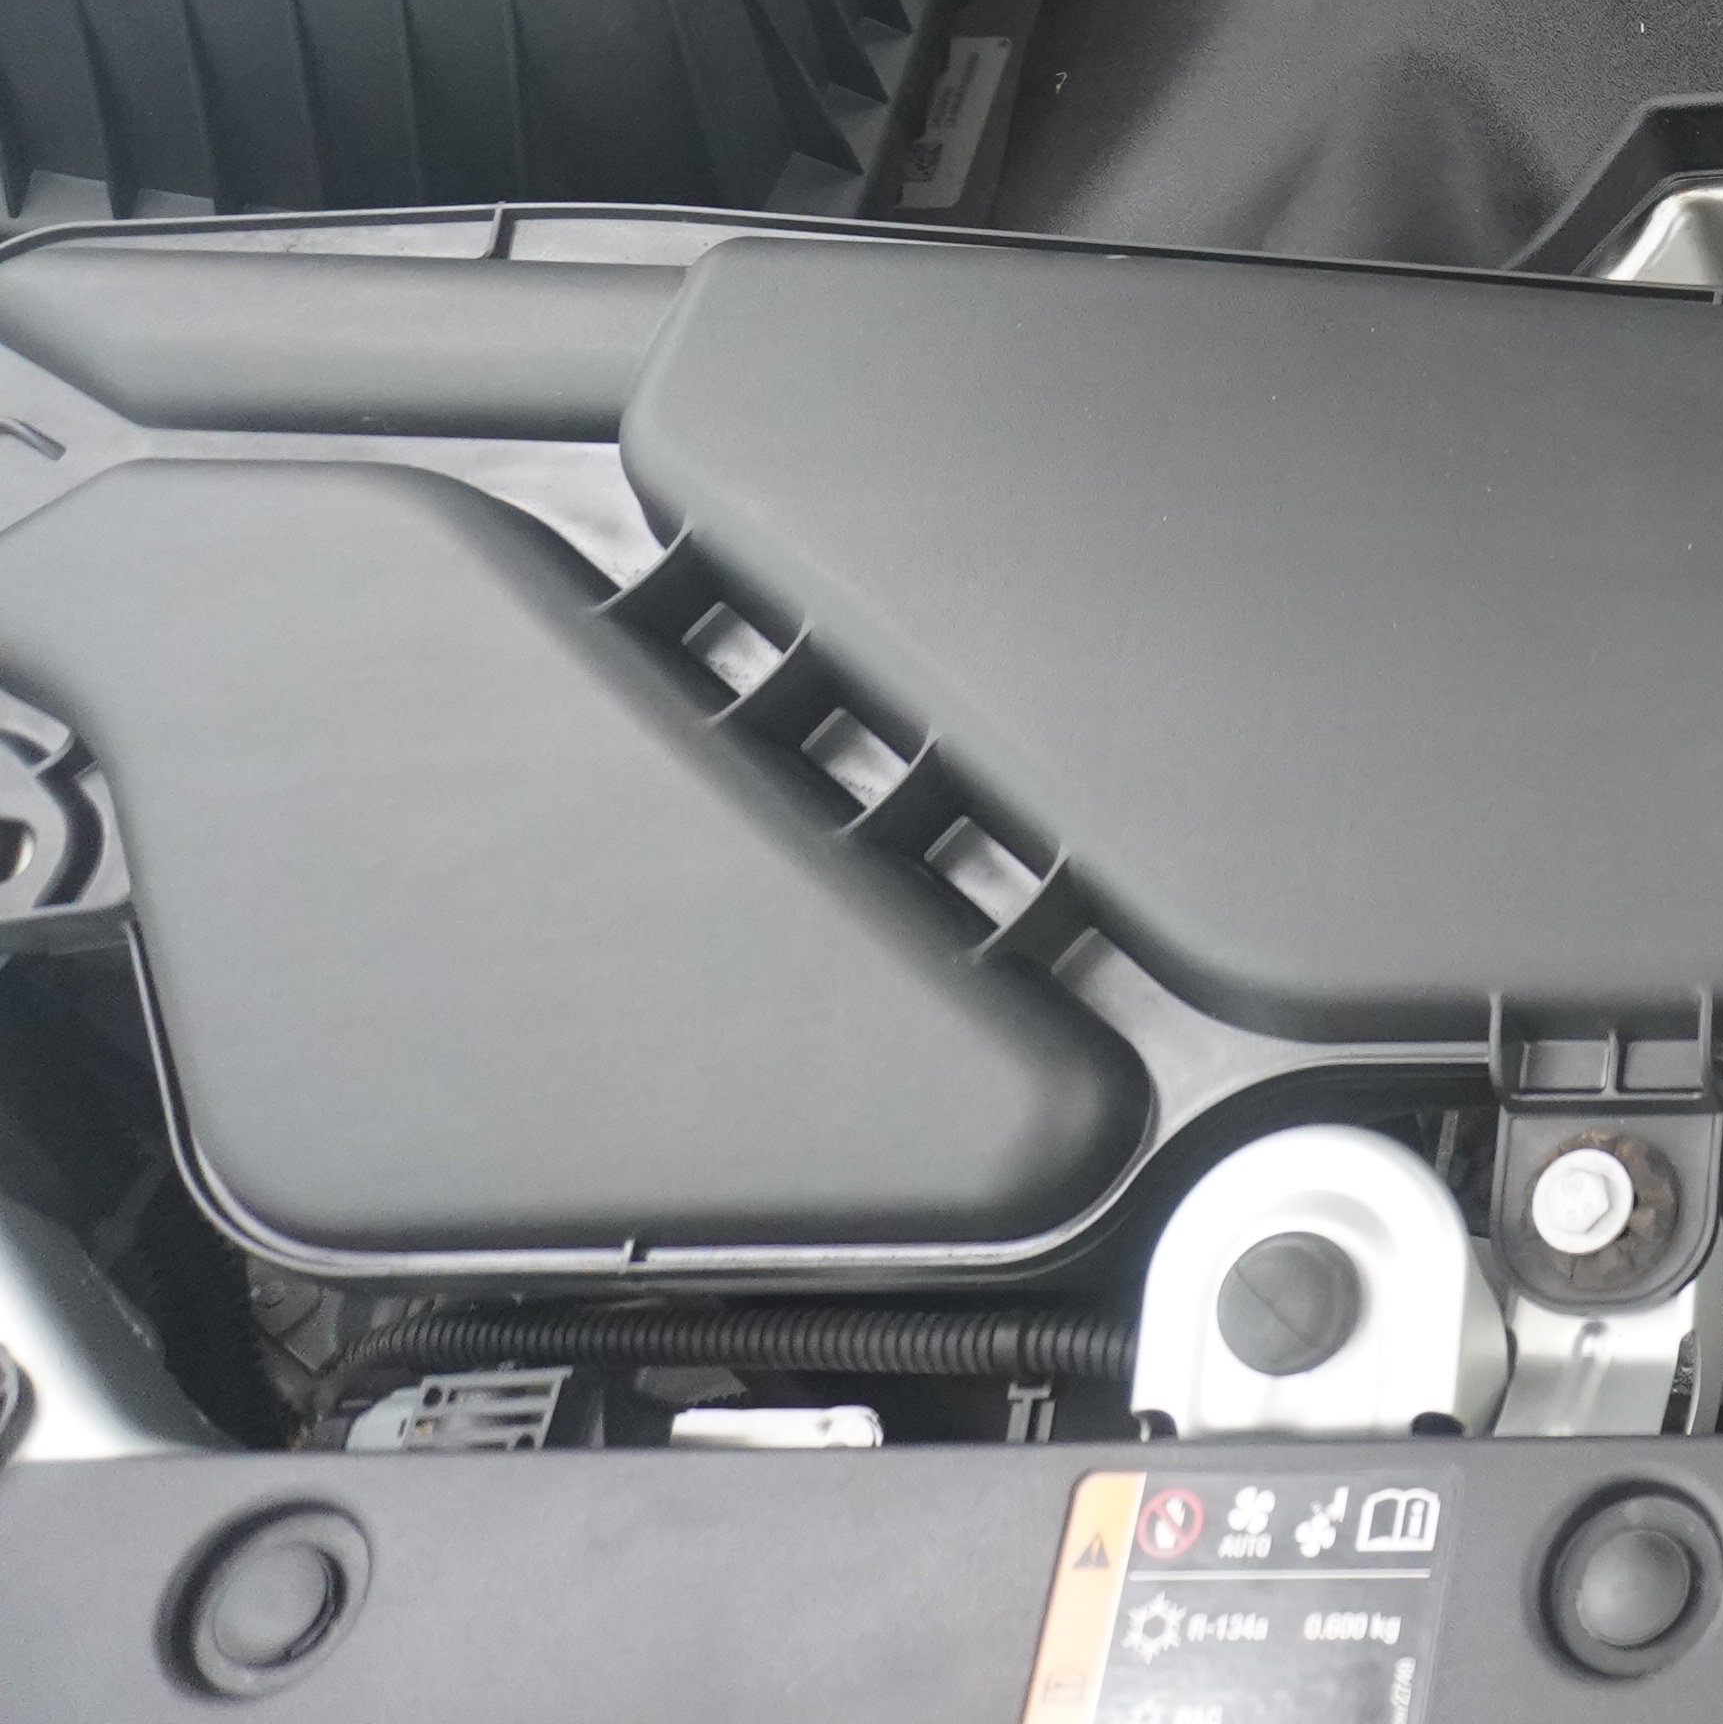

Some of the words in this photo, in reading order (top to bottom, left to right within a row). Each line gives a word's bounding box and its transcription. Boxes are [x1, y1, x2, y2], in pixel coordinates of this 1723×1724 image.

[1217, 1532, 1273, 1559] AUTO
[1186, 1611, 1269, 1643] R-134a
[1370, 1610, 1402, 1646] kg
